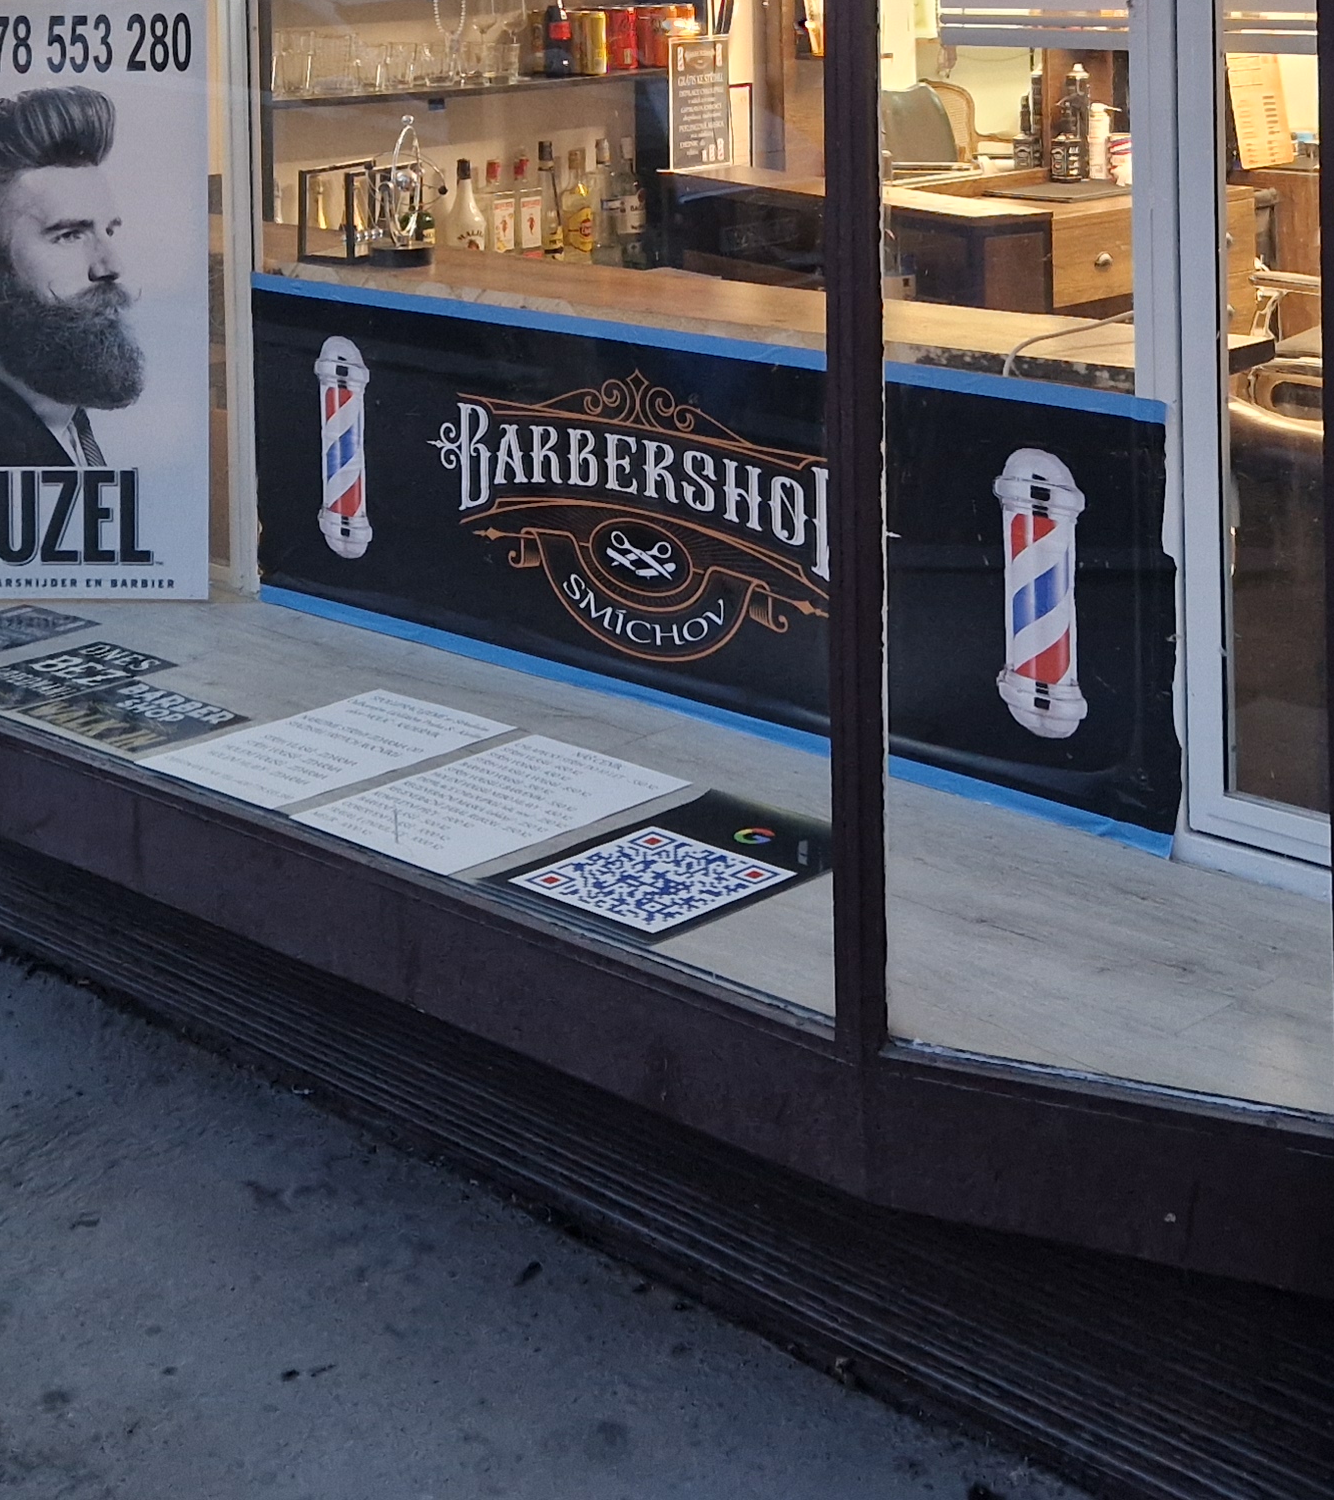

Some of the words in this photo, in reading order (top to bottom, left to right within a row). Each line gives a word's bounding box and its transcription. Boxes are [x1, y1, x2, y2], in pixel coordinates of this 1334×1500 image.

[47, 14, 113, 73] 553
[126, 13, 193, 72] 280
[85, 578, 103, 589] EN
[110, 578, 176, 590] BARBIER
[562, 572, 727, 647] SMÍCHOV
[29, 655, 131, 687] BEZ
[81, 643, 162, 671] DNES
[115, 698, 186, 723] SHOP
[117, 683, 236, 725] BARBER
